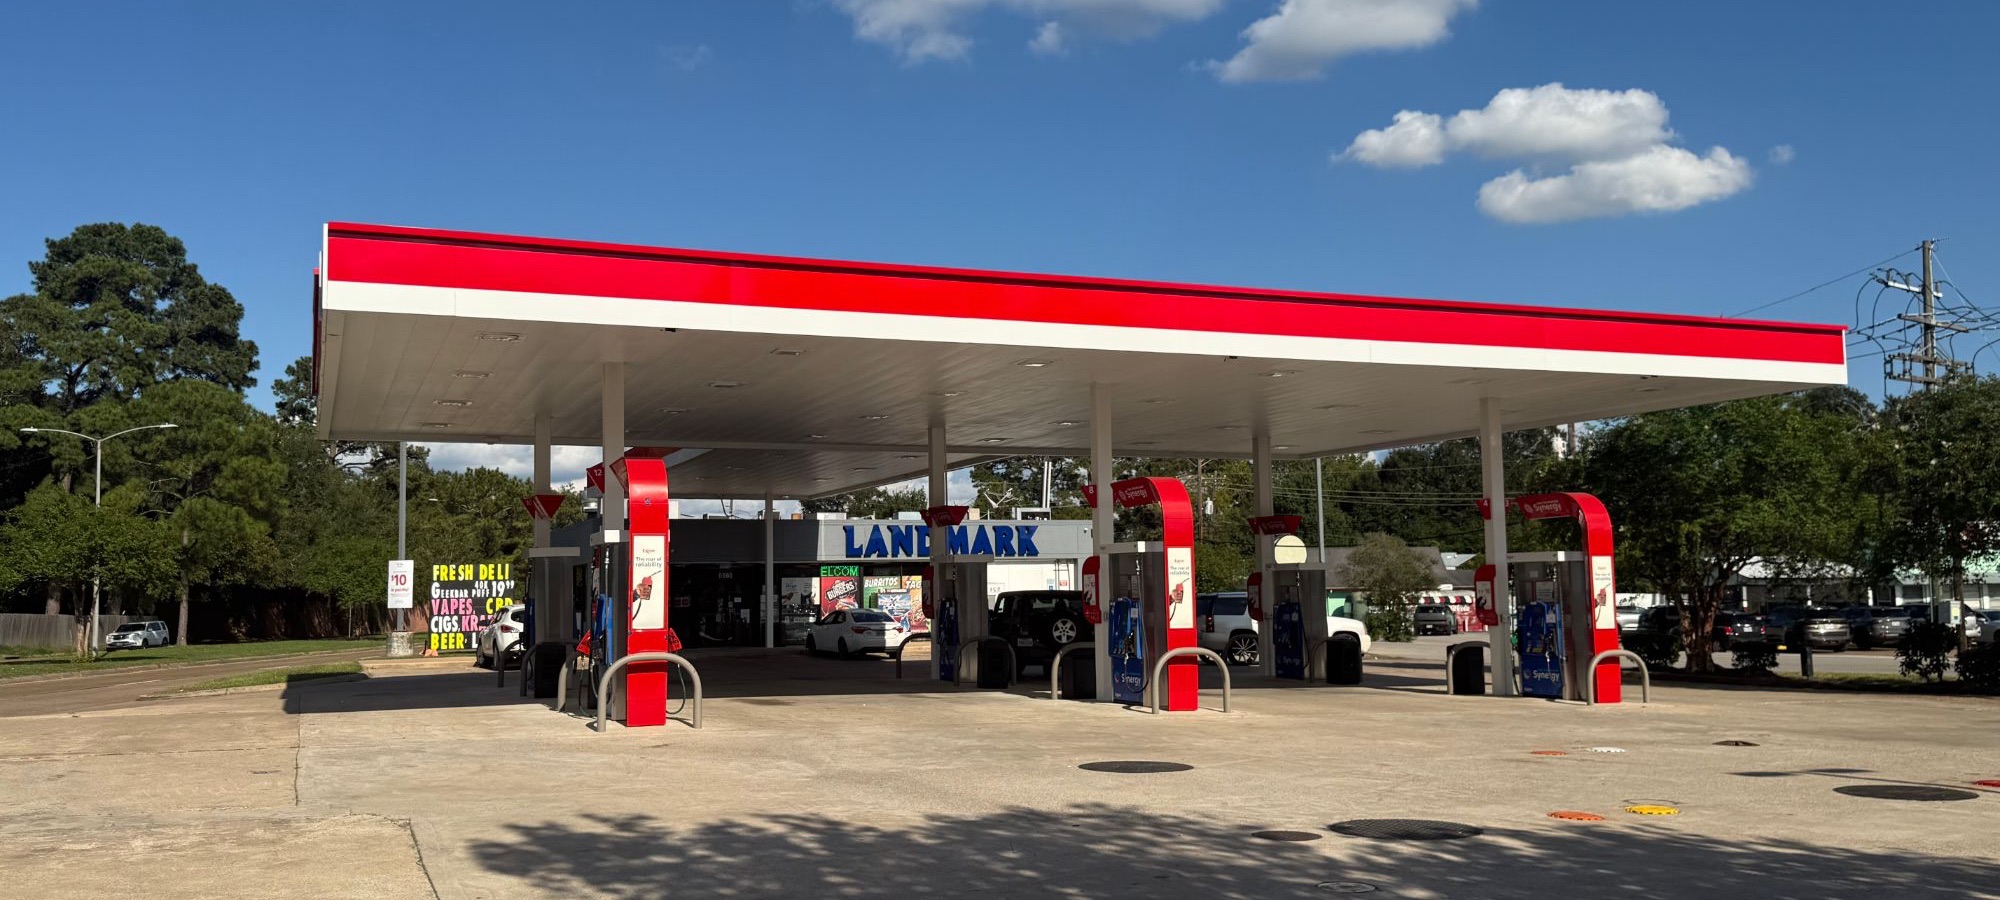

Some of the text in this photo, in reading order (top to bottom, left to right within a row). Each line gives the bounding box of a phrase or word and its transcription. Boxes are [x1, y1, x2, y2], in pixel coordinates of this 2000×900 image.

[594, 469, 602, 477] 12
[1532, 502, 1562, 513] Synergy
[843, 524, 1039, 558] LANDMARK
[433, 563, 510, 581] FRESH DELI
[864, 577, 898, 588] BURRITOS
[472, 589, 490, 598] PUFF
[827, 581, 855, 600] BURGERS
[1121, 673, 1141, 686] Snergy
